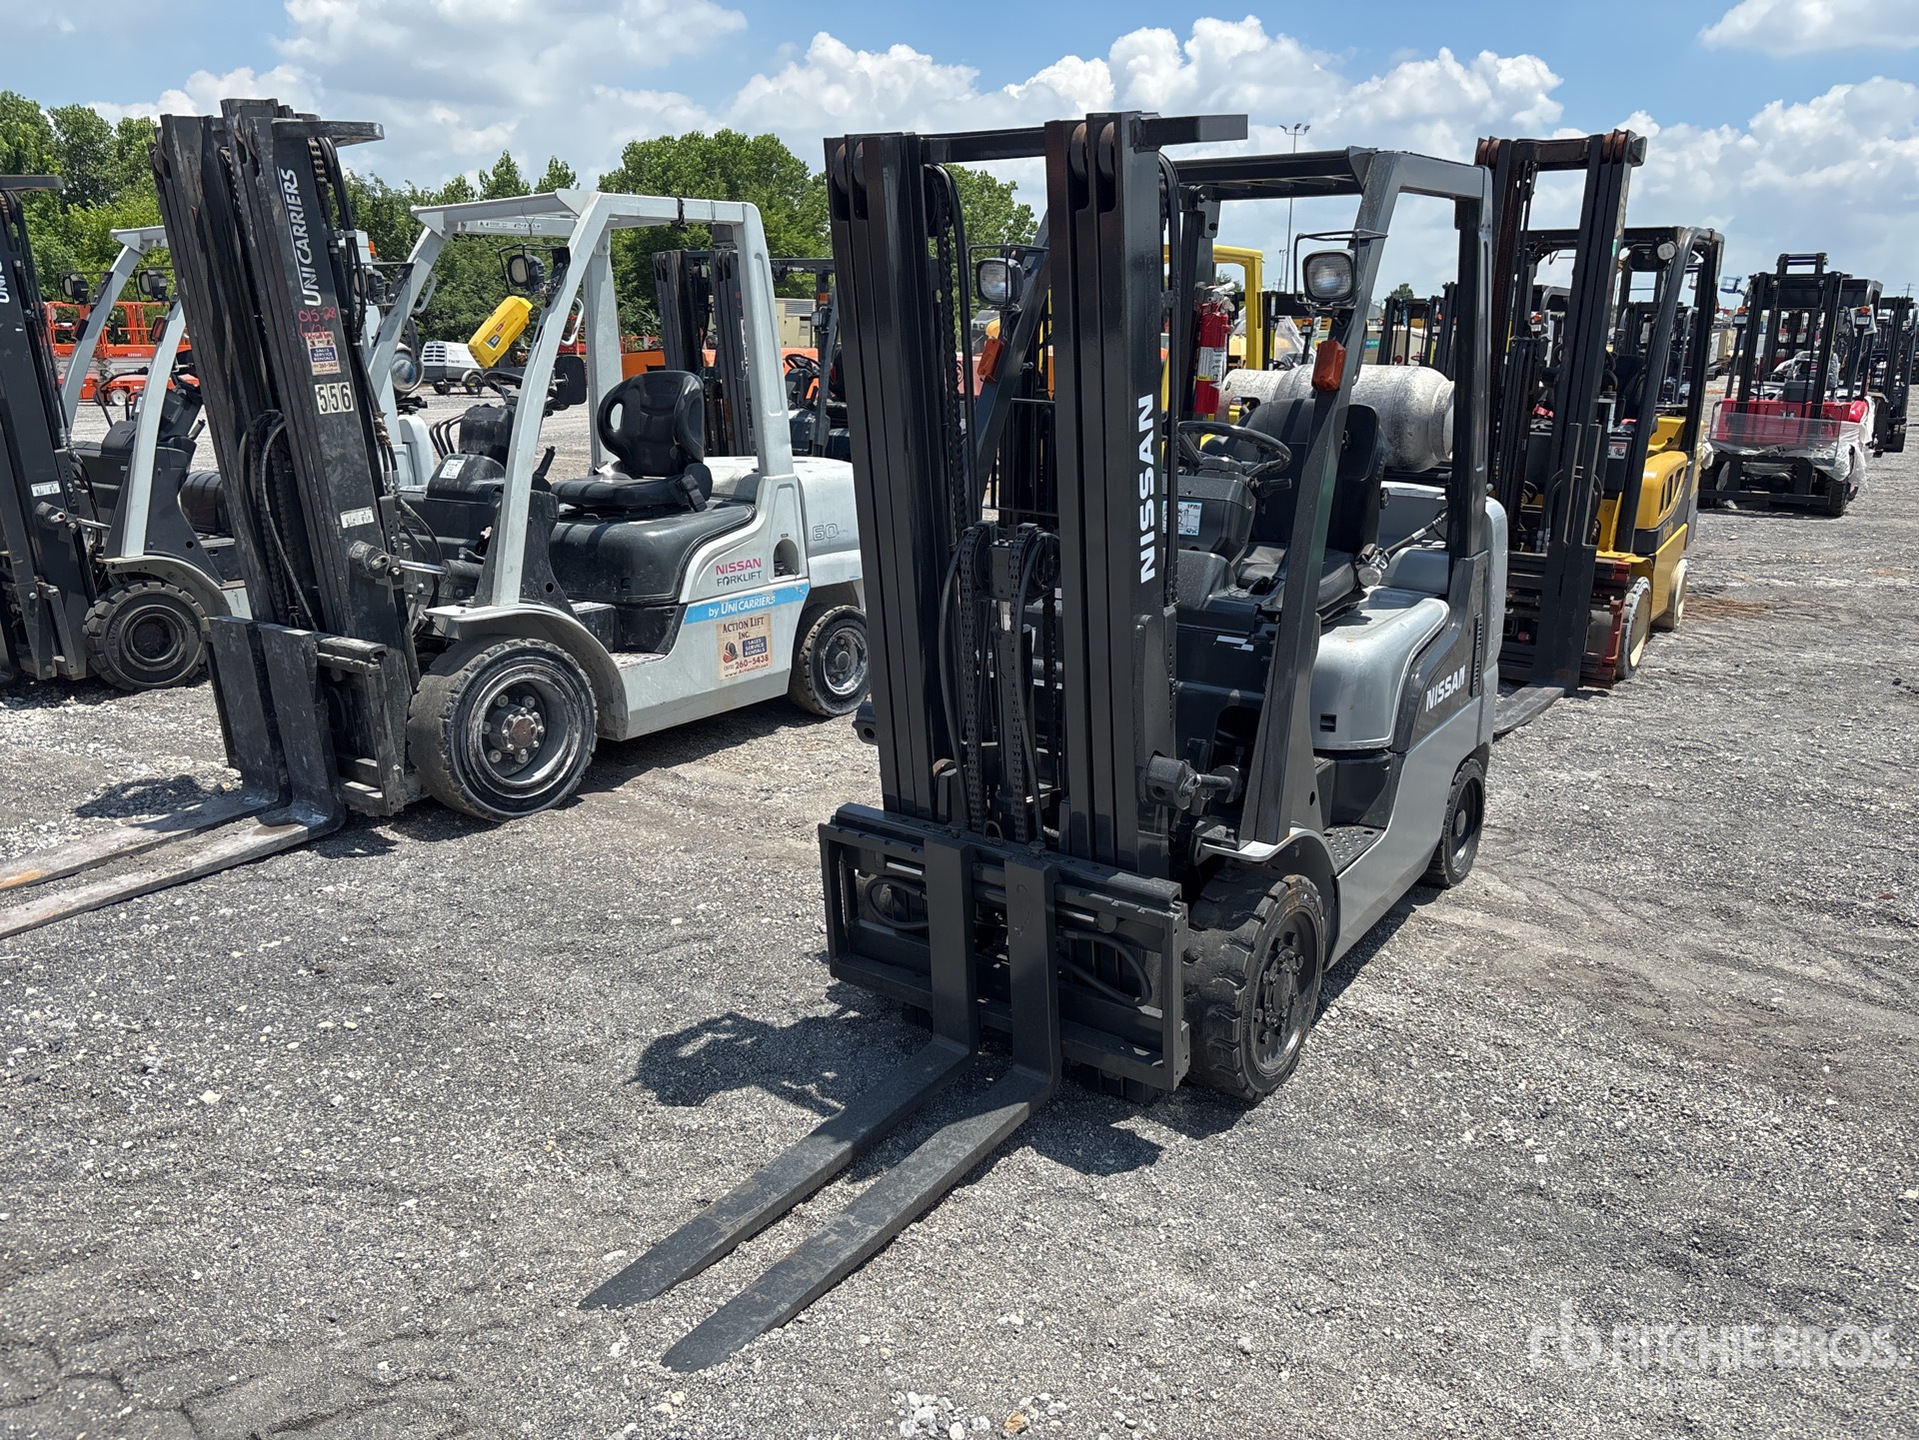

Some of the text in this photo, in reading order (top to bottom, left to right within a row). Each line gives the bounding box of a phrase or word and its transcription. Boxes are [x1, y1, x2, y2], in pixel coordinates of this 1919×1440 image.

[277, 166, 322, 307] UNICARRIERS
[317, 384, 352, 413] 556
[1138, 394, 1156, 584] NISSAN
[715, 558, 762, 576] NISSAN
[716, 570, 762, 587] FORKLIFT
[708, 595, 776, 617] by UNICARRIERS
[723, 616, 765, 634] ACTION LIFT
[1425, 664, 1466, 713] NISSAN
